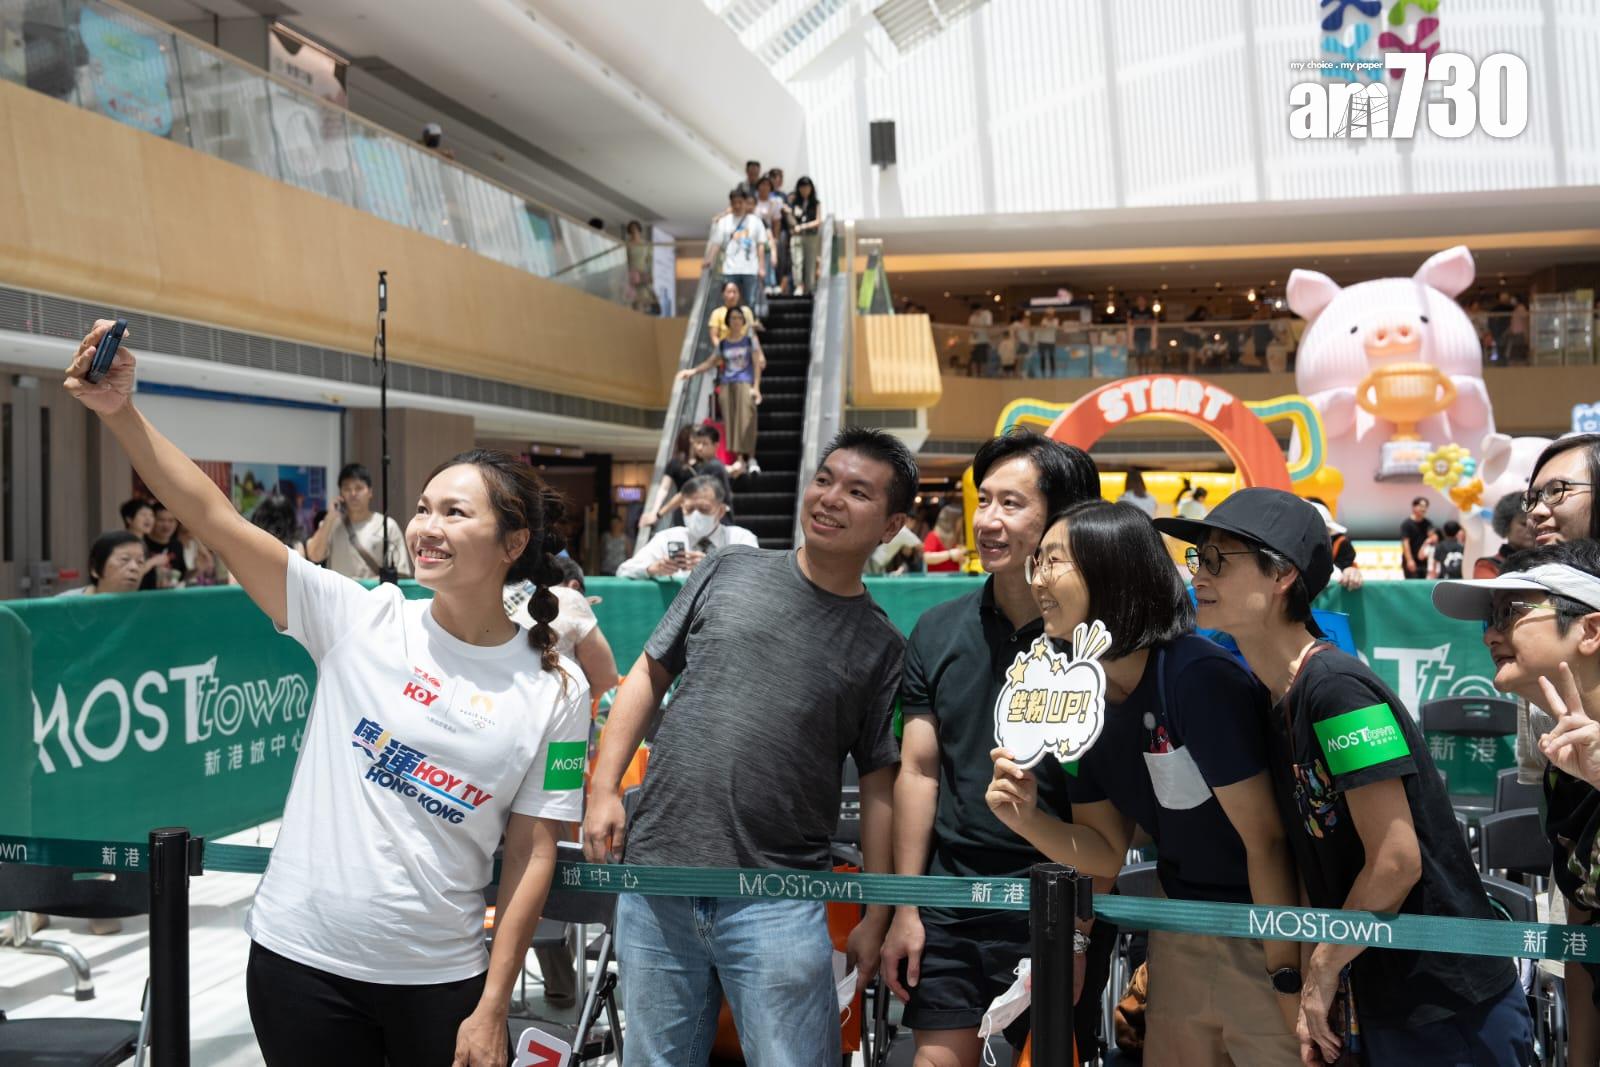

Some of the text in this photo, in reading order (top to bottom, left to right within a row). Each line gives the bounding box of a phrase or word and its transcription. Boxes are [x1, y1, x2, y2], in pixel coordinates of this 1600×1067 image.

[1097, 377, 1234, 423] START
[403, 681, 439, 706] HOY
[1429, 734, 1518, 764] 新港
[365, 766, 465, 824] HONG KONG
[413, 761, 493, 807] HOY TV
[0, 844, 28, 861] wn
[561, 865, 640, 889] 城中心
[739, 871, 863, 900] MOSTown
[971, 882, 1025, 904] 新港
[1249, 909, 1392, 944] MOSTown
[1523, 929, 1588, 956] 新港
